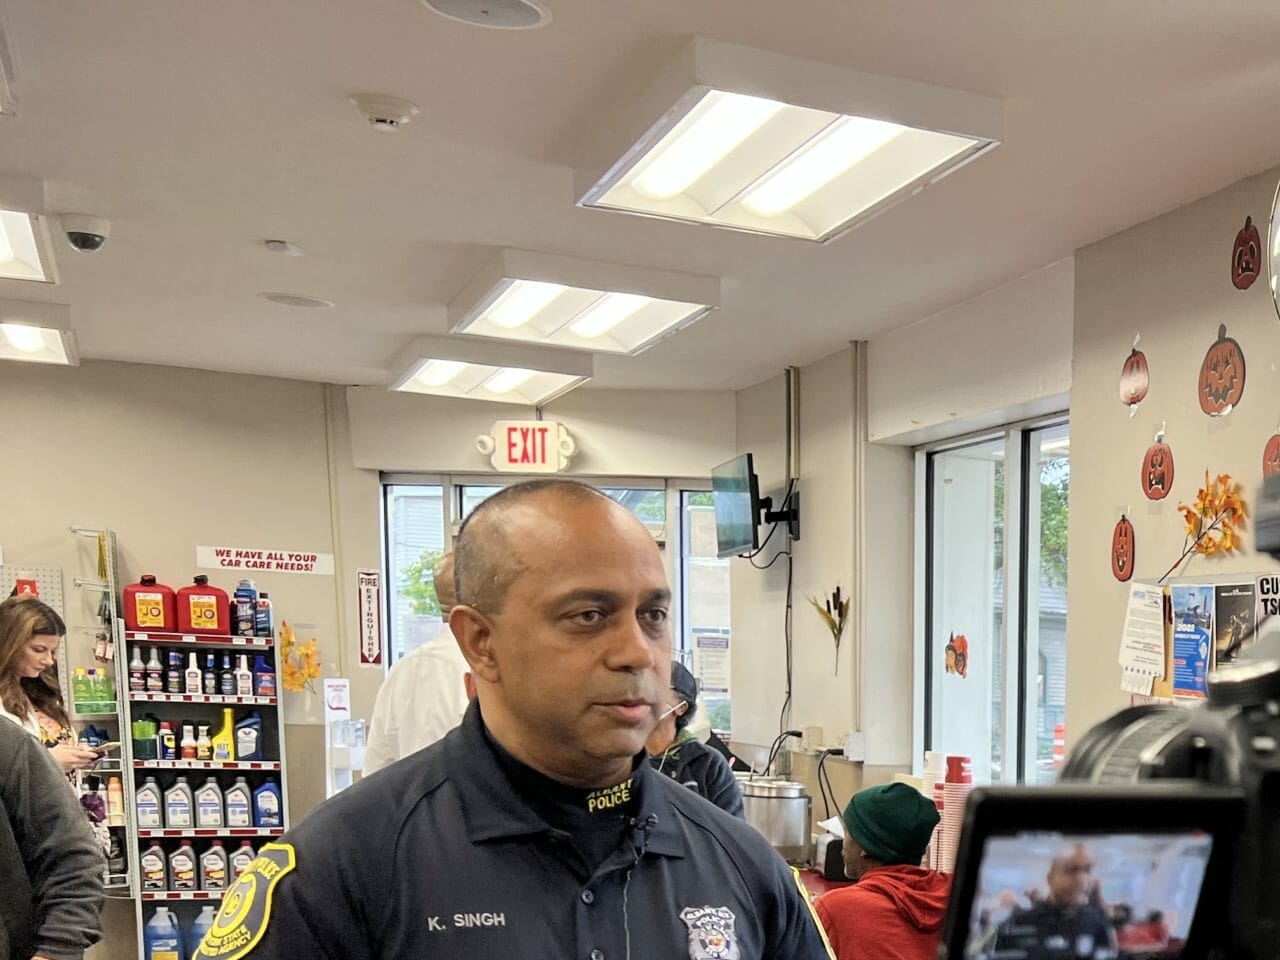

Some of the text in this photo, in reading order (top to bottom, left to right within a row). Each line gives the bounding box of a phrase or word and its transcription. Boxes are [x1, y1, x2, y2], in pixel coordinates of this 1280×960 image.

[507, 427, 549, 464] EXIT
[215, 549, 317, 563] WE HAVE ALL YOUR
[220, 559, 314, 571] CAR CARE NEEDS!
[360, 577, 377, 587] FIRE
[366, 588, 374, 658] EXTINGUISHER
[588, 789, 631, 812] POLICE
[427, 912, 506, 931] K. SINGH
